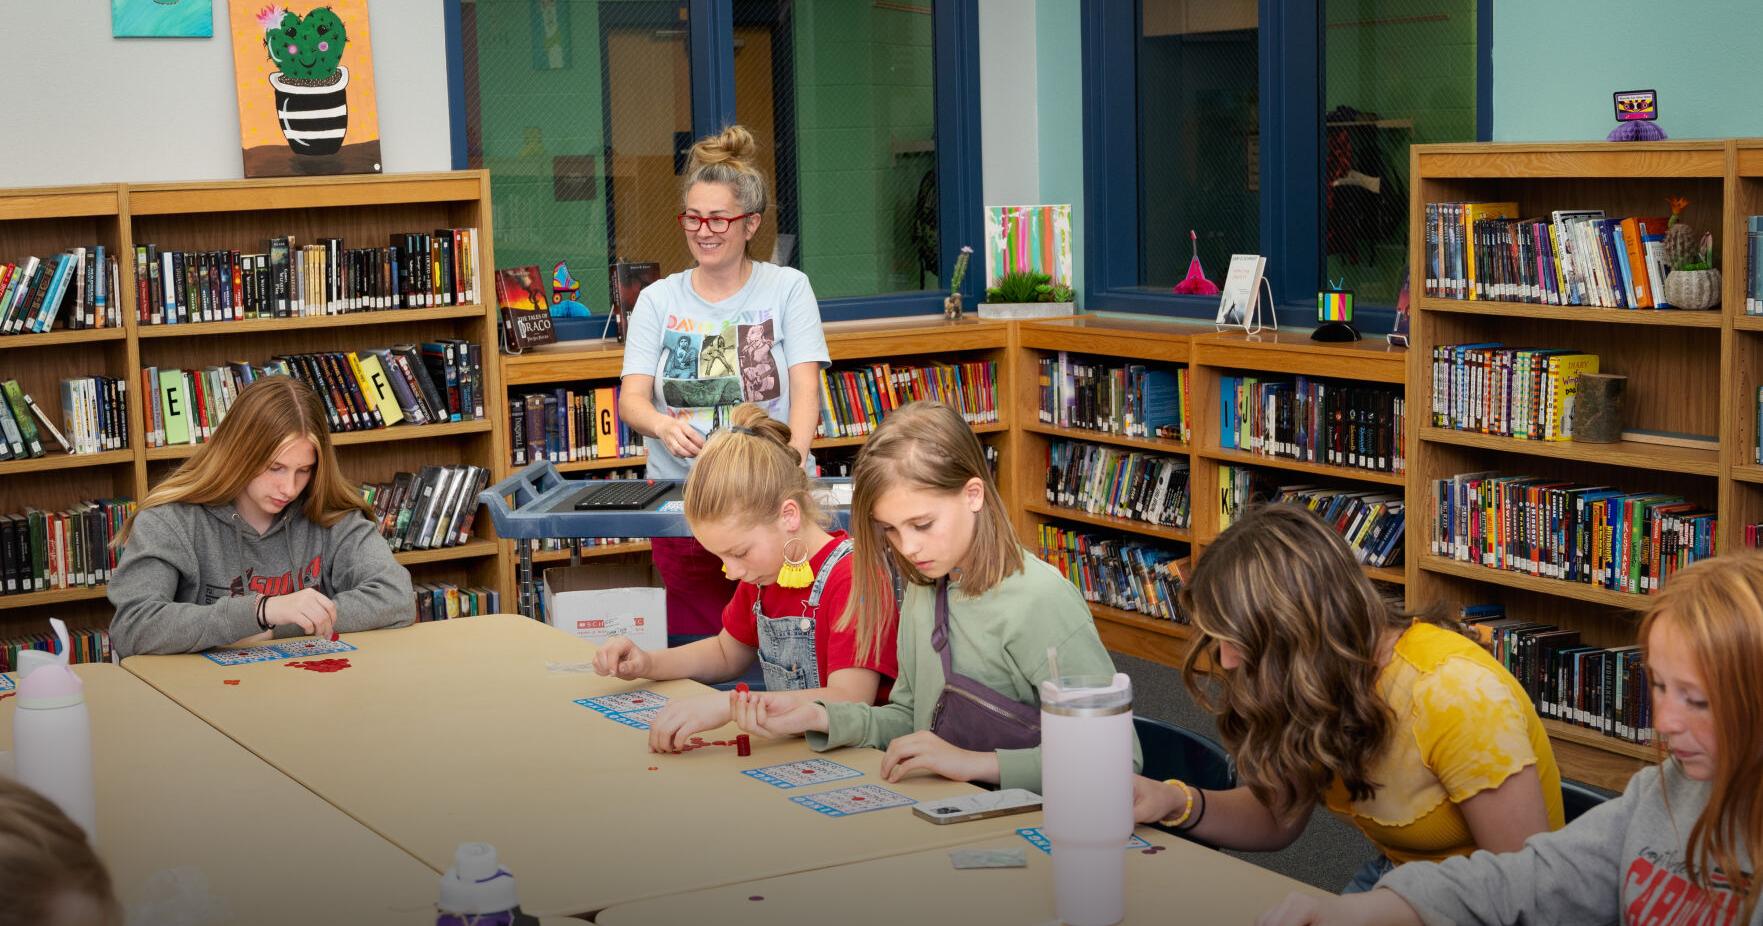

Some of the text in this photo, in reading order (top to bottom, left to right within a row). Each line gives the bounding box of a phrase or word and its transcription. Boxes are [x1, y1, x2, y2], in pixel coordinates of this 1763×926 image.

[517, 319, 551, 338] DRACO
[371, 372, 385, 400] F
[166, 387, 181, 416] E
[1242, 396, 1249, 423] J
[601, 408, 611, 436] G
[1221, 487, 1229, 515] K
